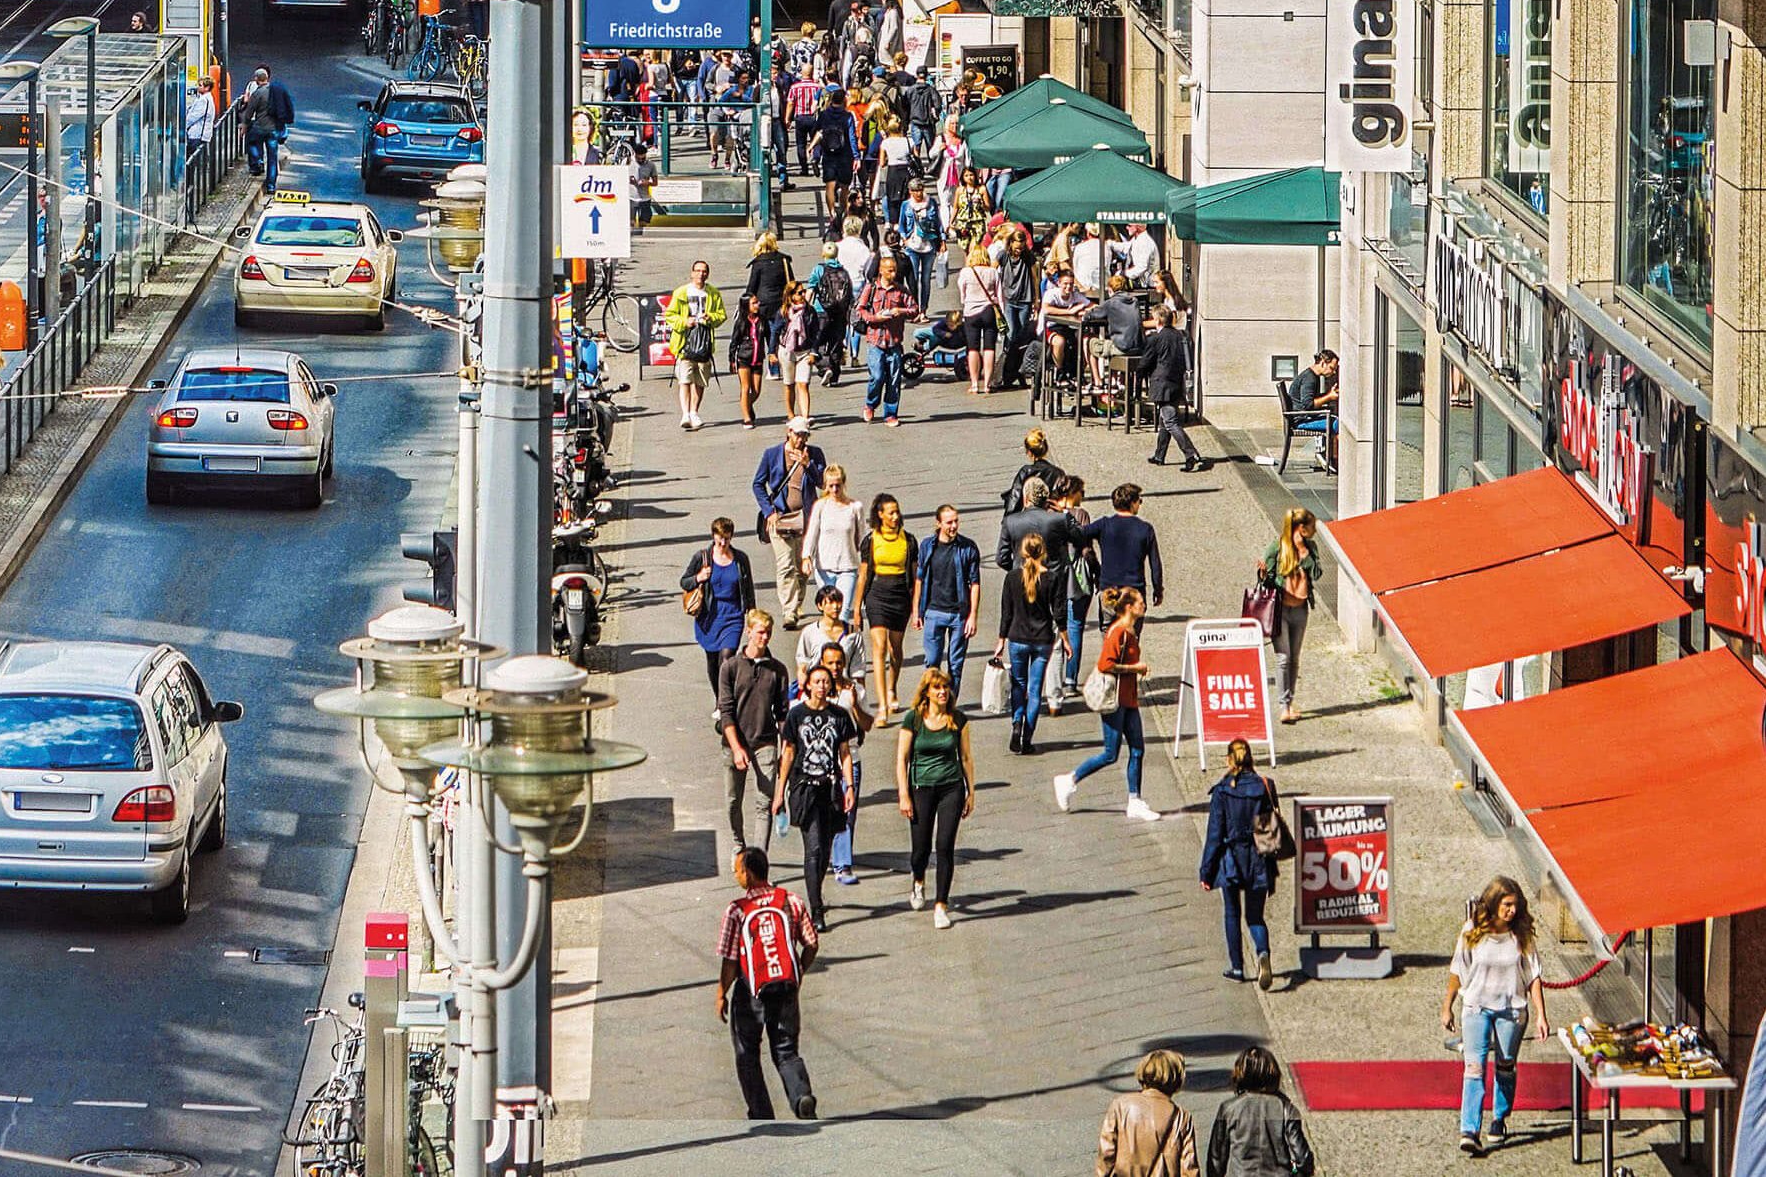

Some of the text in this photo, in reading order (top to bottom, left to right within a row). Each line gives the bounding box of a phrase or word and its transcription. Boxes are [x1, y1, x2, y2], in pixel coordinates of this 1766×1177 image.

[610, 22, 723, 39] Friedrichstraße
[966, 56, 991, 64] COFFEE
[580, 174, 612, 194] dm
[1096, 211, 1155, 220] STARBUCKS
[1207, 674, 1254, 691] FINAL
[1208, 691, 1257, 711] SALE
[1315, 804, 1367, 821] LAGER
[1304, 817, 1386, 840] RÄUMUNG
[1302, 850, 1389, 892] 50%
[1318, 892, 1375, 909] RADIKAL
[1316, 902, 1380, 921] REDUZIERT
